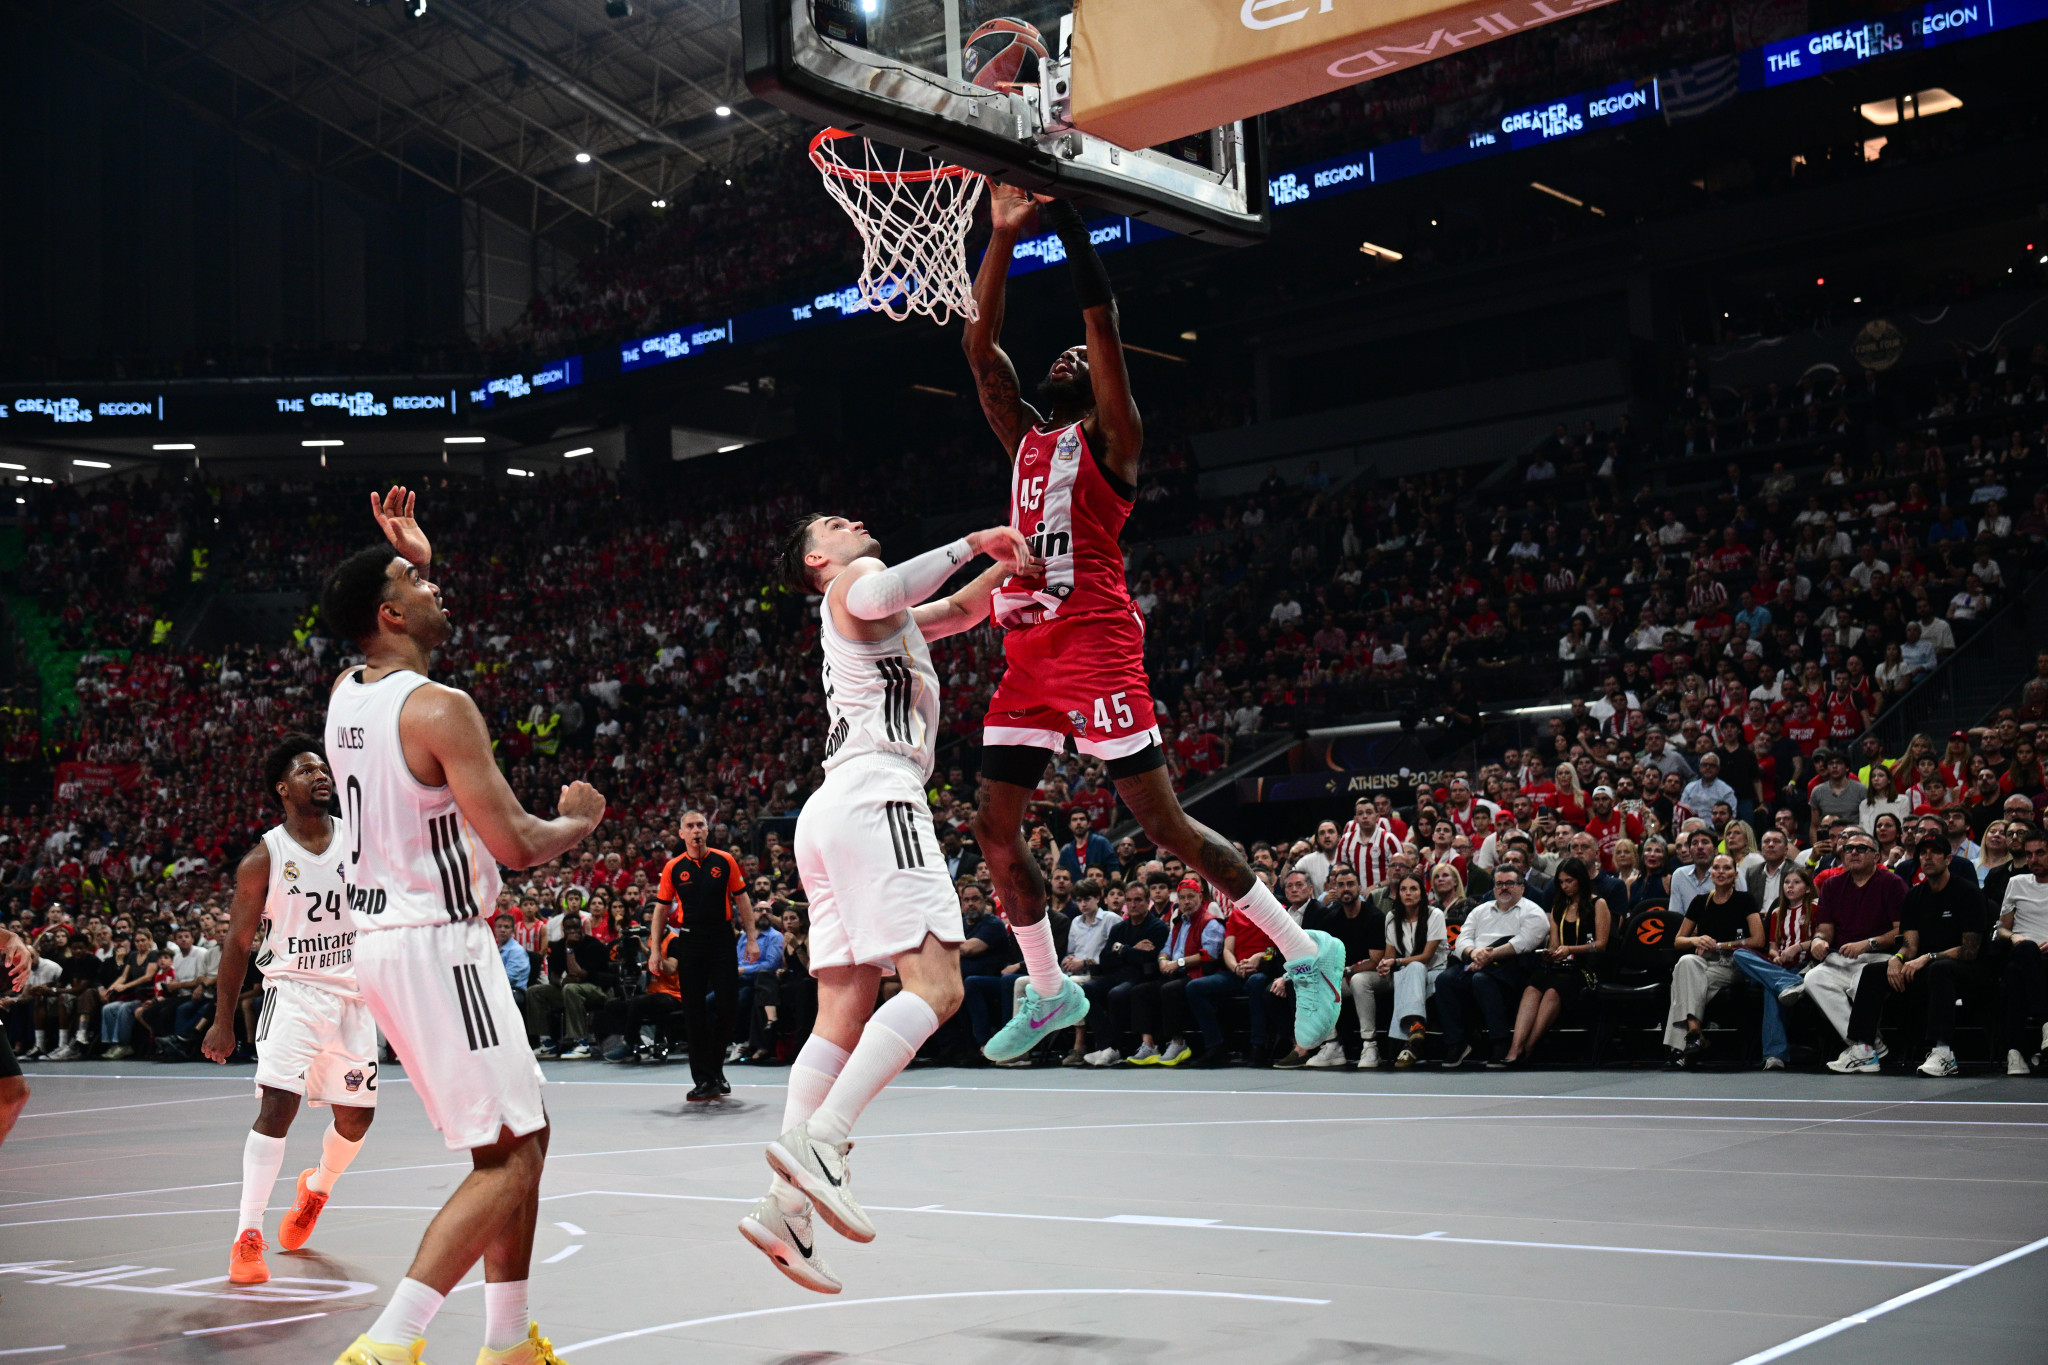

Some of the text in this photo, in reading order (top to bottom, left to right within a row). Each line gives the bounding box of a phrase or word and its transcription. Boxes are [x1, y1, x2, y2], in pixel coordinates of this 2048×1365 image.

[1767, 51, 1801, 72] THE
[1911, 5, 1978, 37] REGION
[1589, 89, 1647, 119] REGION
[1314, 162, 1364, 189] REGION
[1089, 224, 1121, 246] GION
[791, 304, 813, 321] THE
[622, 348, 641, 364] THE
[691, 327, 727, 347] REGION
[470, 388, 487, 404] THE
[532, 368, 564, 387] REGION
[98, 401, 152, 416] REGION
[276, 399, 305, 413] THE
[392, 396, 446, 410] REGION
[1020, 475, 1045, 514] 45
[1093, 691, 1134, 734] 45
[1832, 714, 1847, 726] 25
[1347, 774, 1399, 792] ATHENS
[305, 890, 341, 922] 24
[297, 948, 352, 970] FLY BETTER
